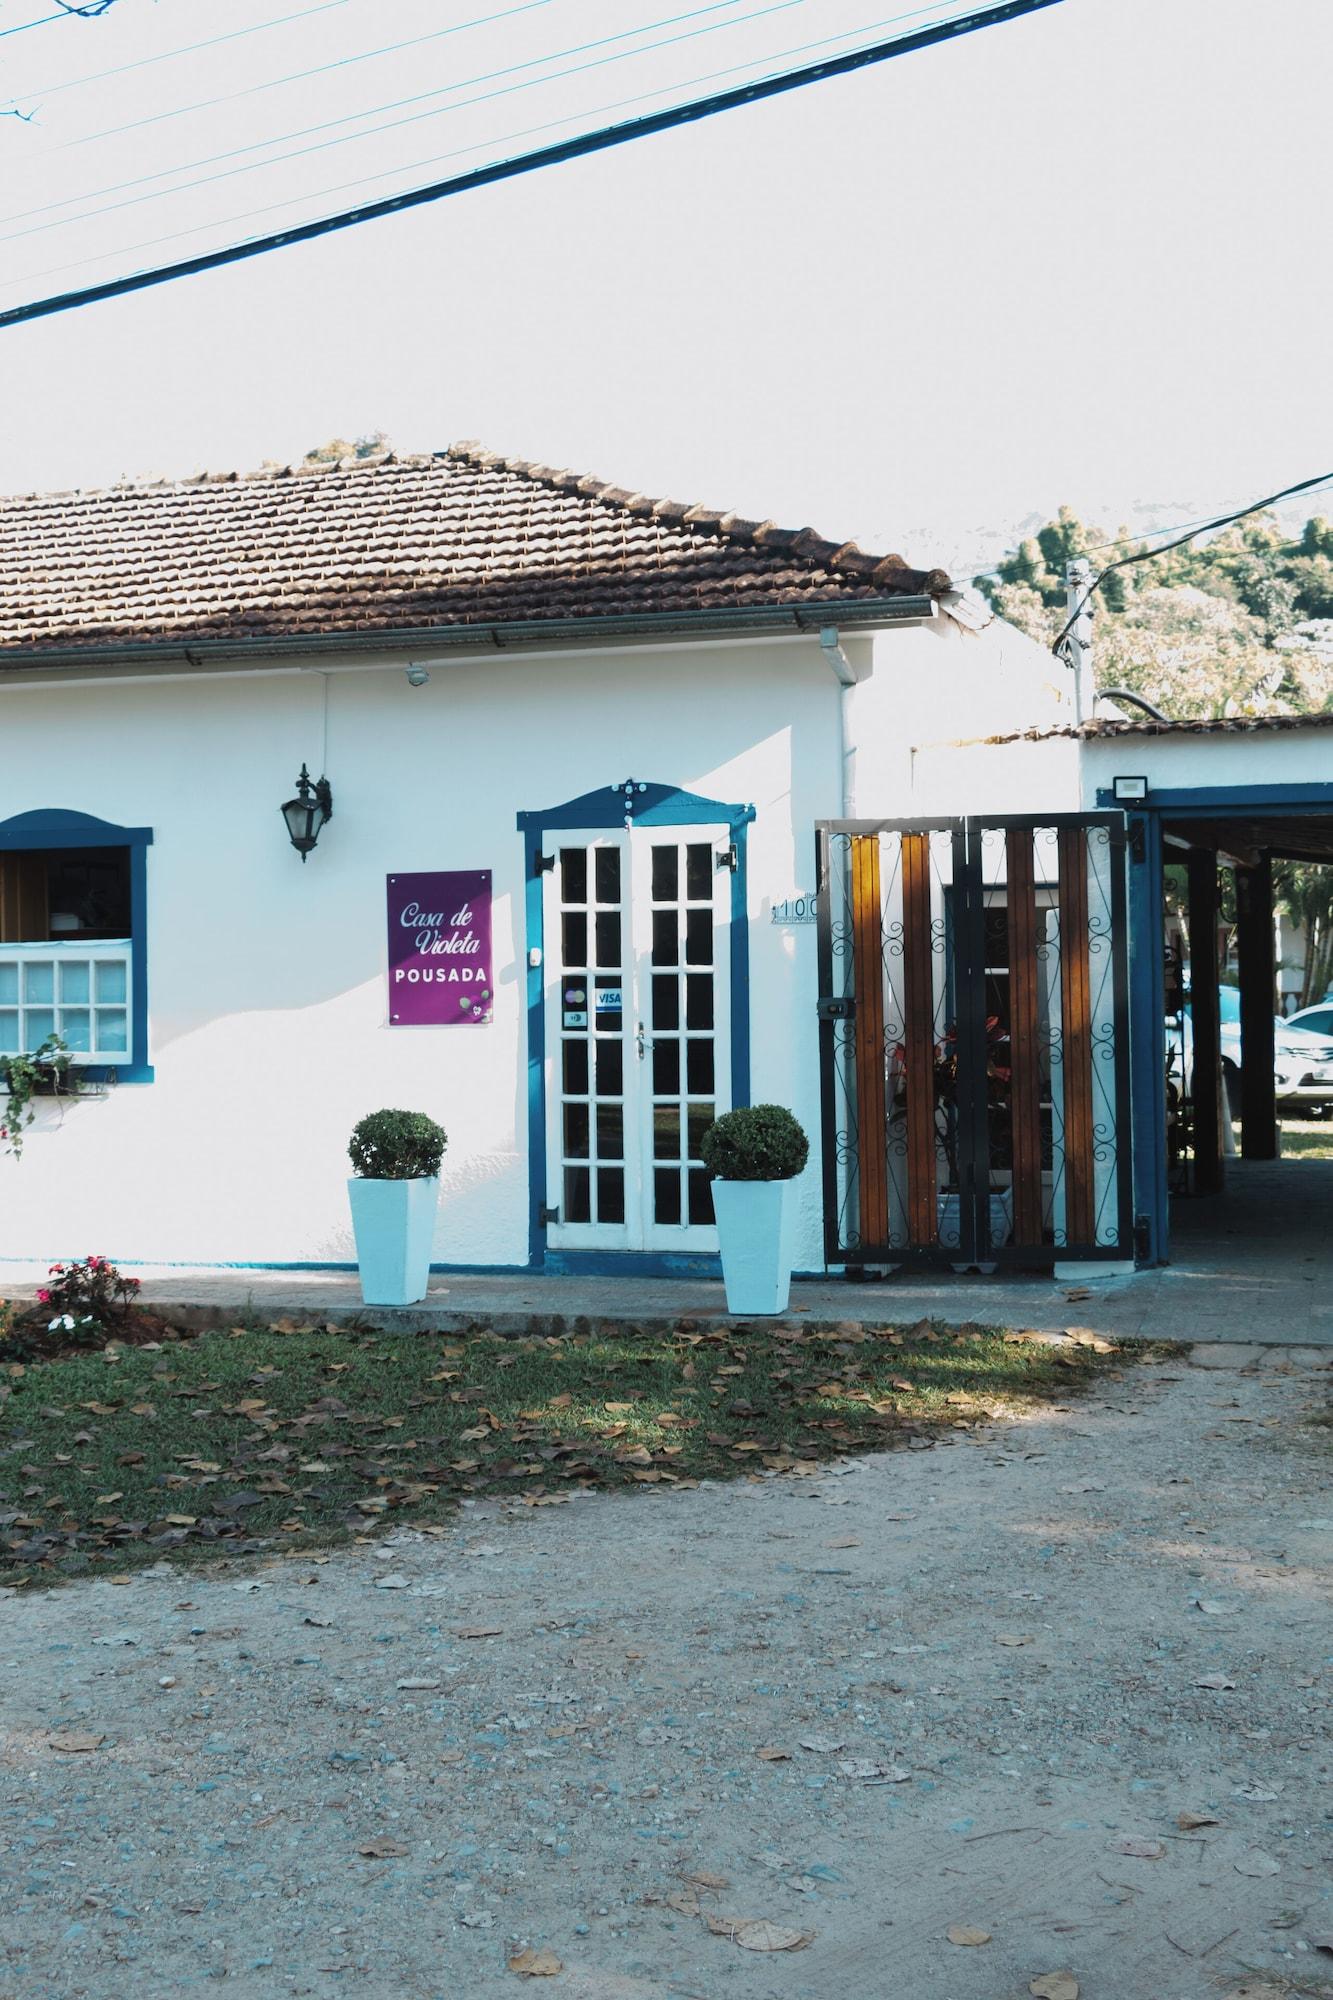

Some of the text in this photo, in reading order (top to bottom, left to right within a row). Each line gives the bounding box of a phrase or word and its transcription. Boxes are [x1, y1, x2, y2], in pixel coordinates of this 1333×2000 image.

[400, 902, 473, 928] Casa de
[415, 929, 480, 956] Violeta
[395, 967, 487, 983] POUSADA
[599, 993, 621, 1004] VISA
